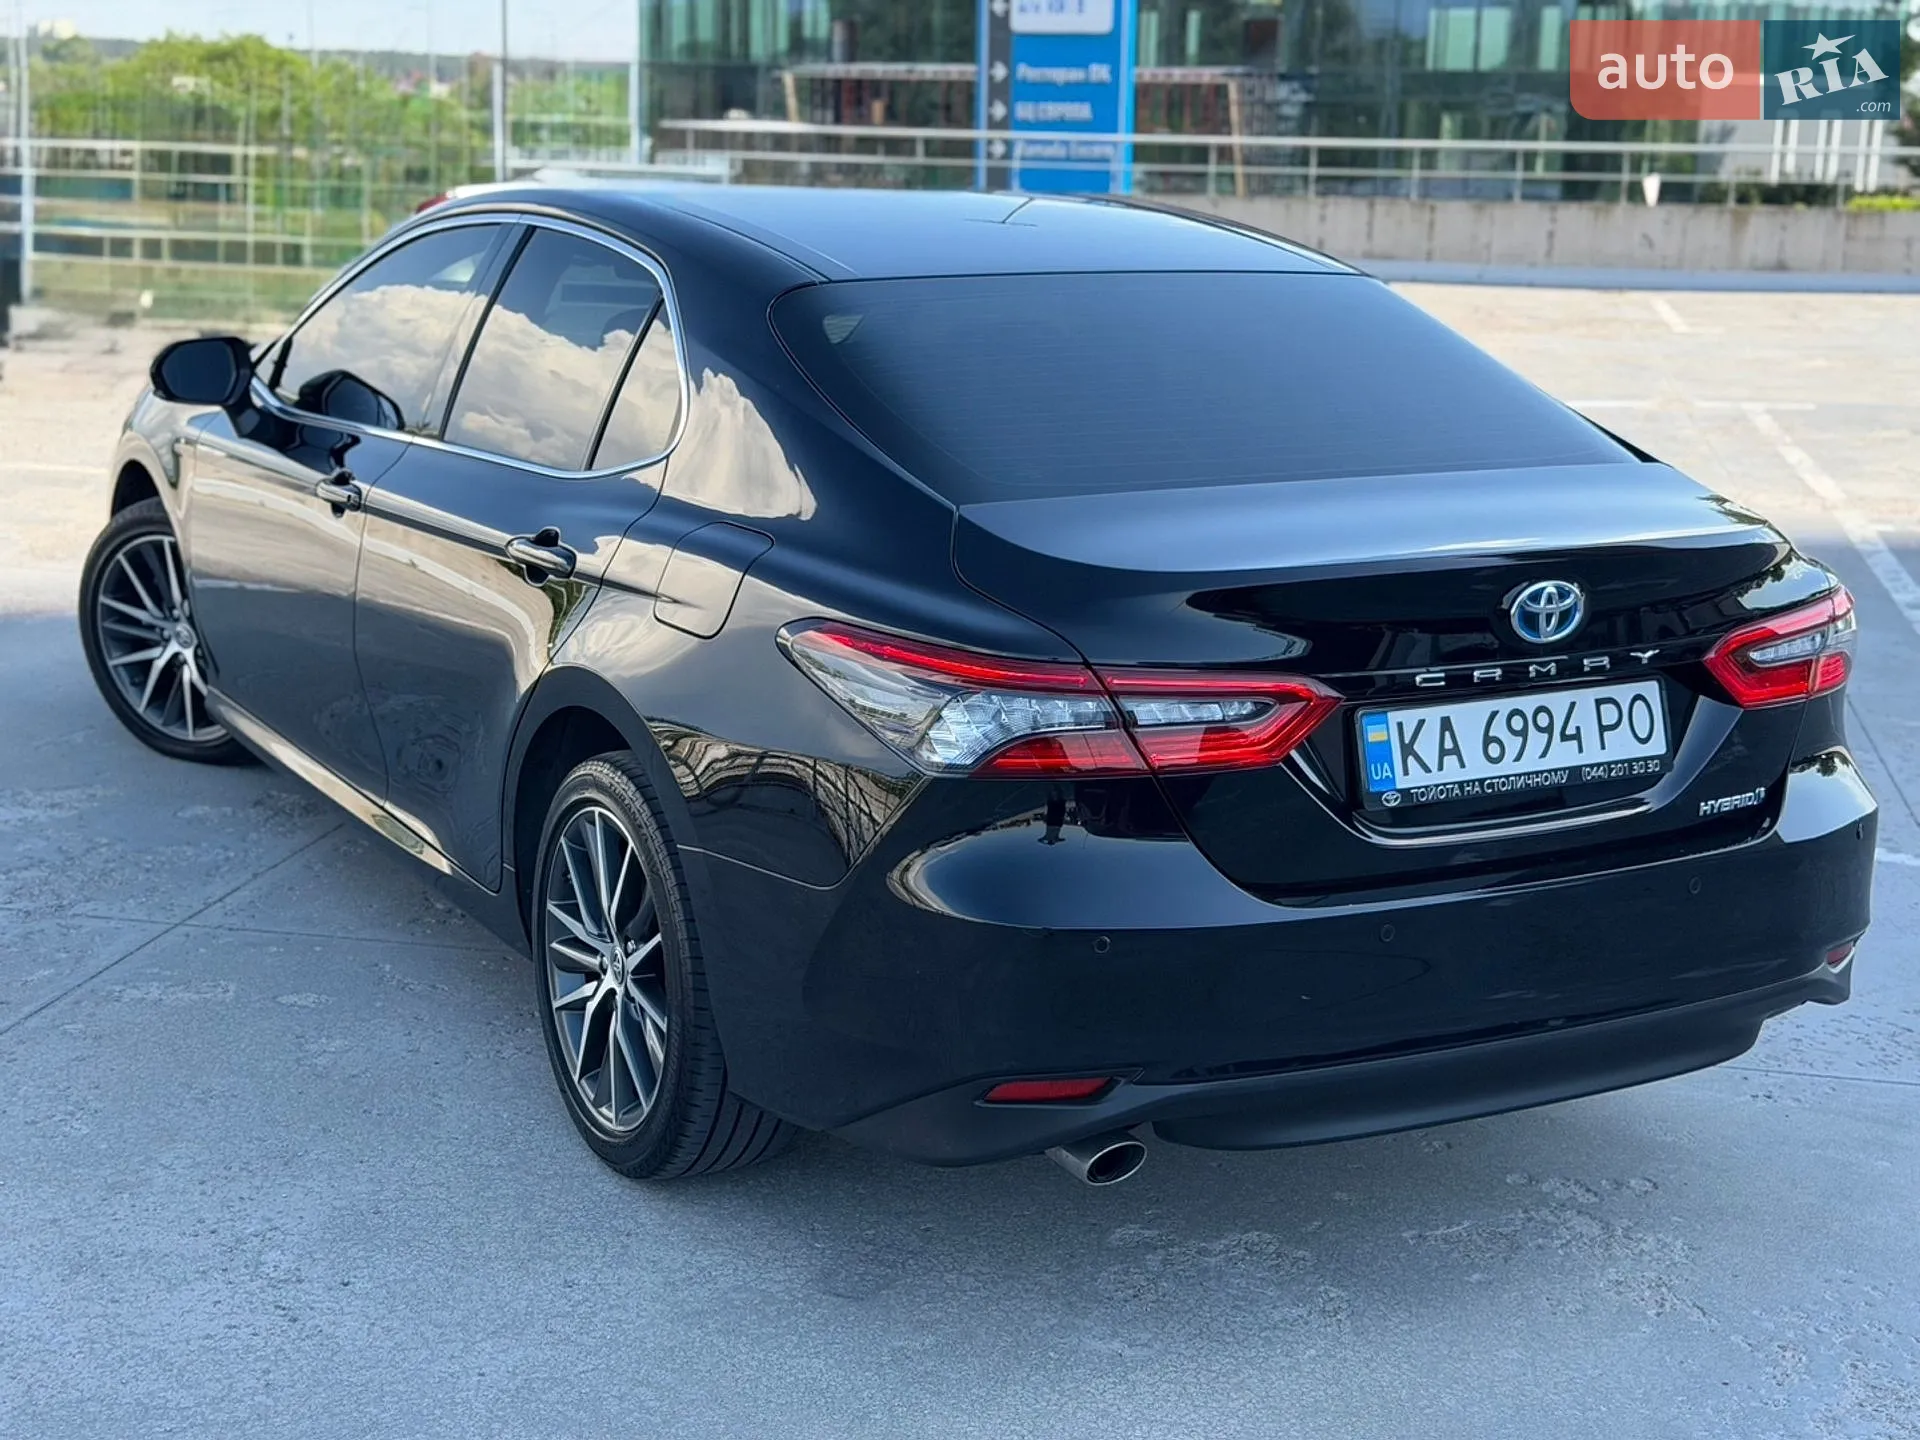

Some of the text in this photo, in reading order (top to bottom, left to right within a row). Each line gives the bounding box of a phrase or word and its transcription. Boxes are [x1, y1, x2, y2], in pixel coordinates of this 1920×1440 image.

[1415, 650, 1660, 687] CAMRY
[1396, 715, 1466, 777] KA
[1481, 700, 1584, 765] 6994
[1371, 762, 1393, 780] UA
[1409, 784, 1461, 803] ТОЙОТА
[1463, 780, 1482, 797] НА
[1483, 769, 1569, 793] СТОЛИЧНОМУ
[1581, 765, 1609, 781] (044)
[1610, 763, 1629, 777] 201
[1699, 791, 1755, 817] HYBRID
